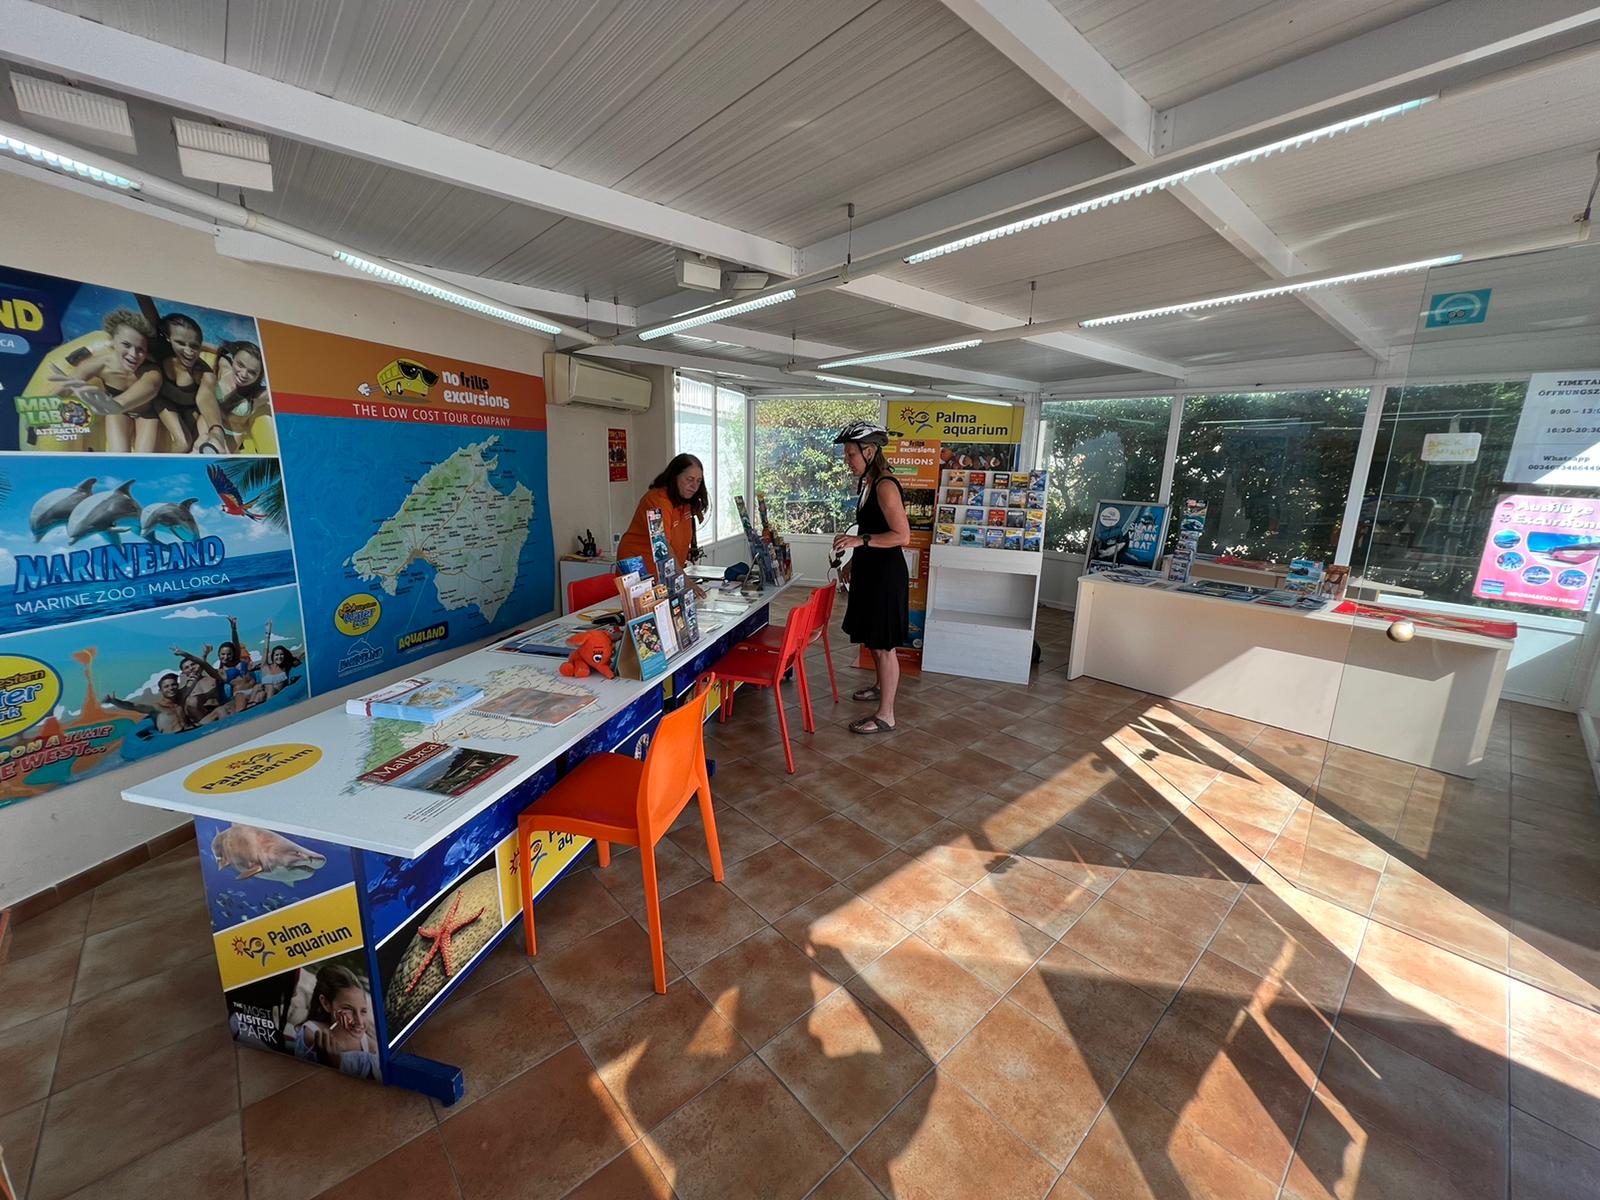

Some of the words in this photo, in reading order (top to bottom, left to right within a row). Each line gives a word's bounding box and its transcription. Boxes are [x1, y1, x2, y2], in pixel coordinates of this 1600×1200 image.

[460, 371, 490, 392] frills
[15, 396, 62, 411] MAD
[443, 389, 511, 410] excursions
[26, 411, 64, 425] LAB
[352, 403, 378, 417] THE
[382, 406, 409, 419] LOW
[412, 408, 439, 422] COST
[443, 411, 469, 424] TOUR
[470, 414, 511, 426] COMPANY
[936, 411, 977, 424] Palma
[36, 427, 91, 435] ATTRACTION
[943, 423, 1009, 438] aquarium
[887, 457, 934, 466] CURSIONS
[14, 535, 226, 595] MARINELAND
[15, 590, 92, 616] MARINE
[96, 586, 137, 604] ZOO
[148, 573, 231, 595] MALLORCA
[398, 625, 446, 650] AQUALAND
[227, 748, 314, 788] aquarium
[372, 743, 439, 777] Mallorca
[200, 764, 264, 791] Palma
[267, 922, 313, 946] Palma
[285, 926, 353, 958] aquarium
[235, 1012, 275, 1029] VISITED
[243, 1004, 272, 1020] MOST
[238, 1021, 278, 1044] PARK
